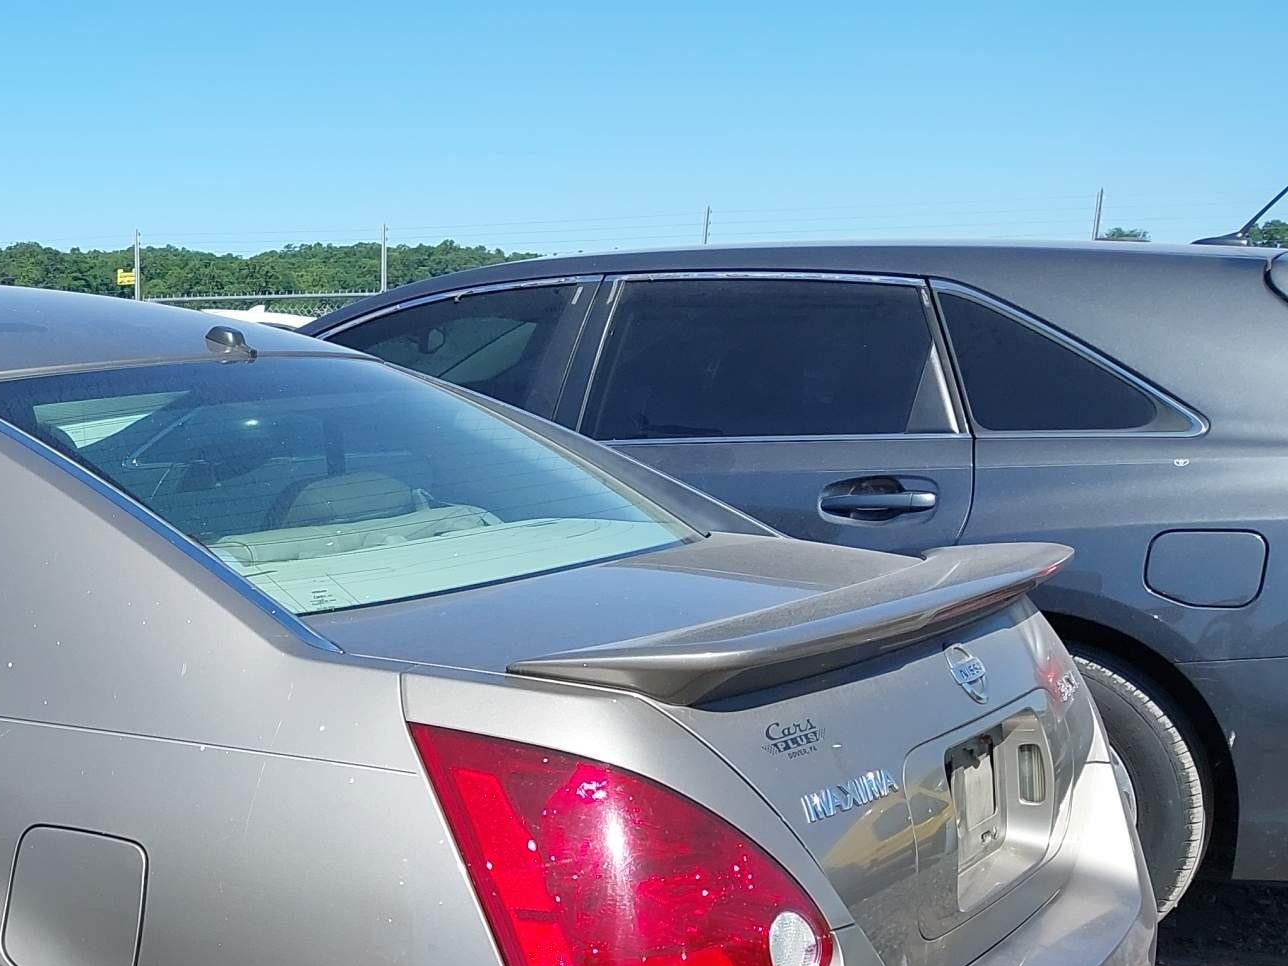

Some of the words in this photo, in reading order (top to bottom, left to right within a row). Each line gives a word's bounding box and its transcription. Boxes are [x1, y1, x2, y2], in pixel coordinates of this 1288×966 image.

[765, 718, 817, 741] Cars
[775, 732, 818, 752] PLUS
[800, 769, 899, 824] MAXIMA
